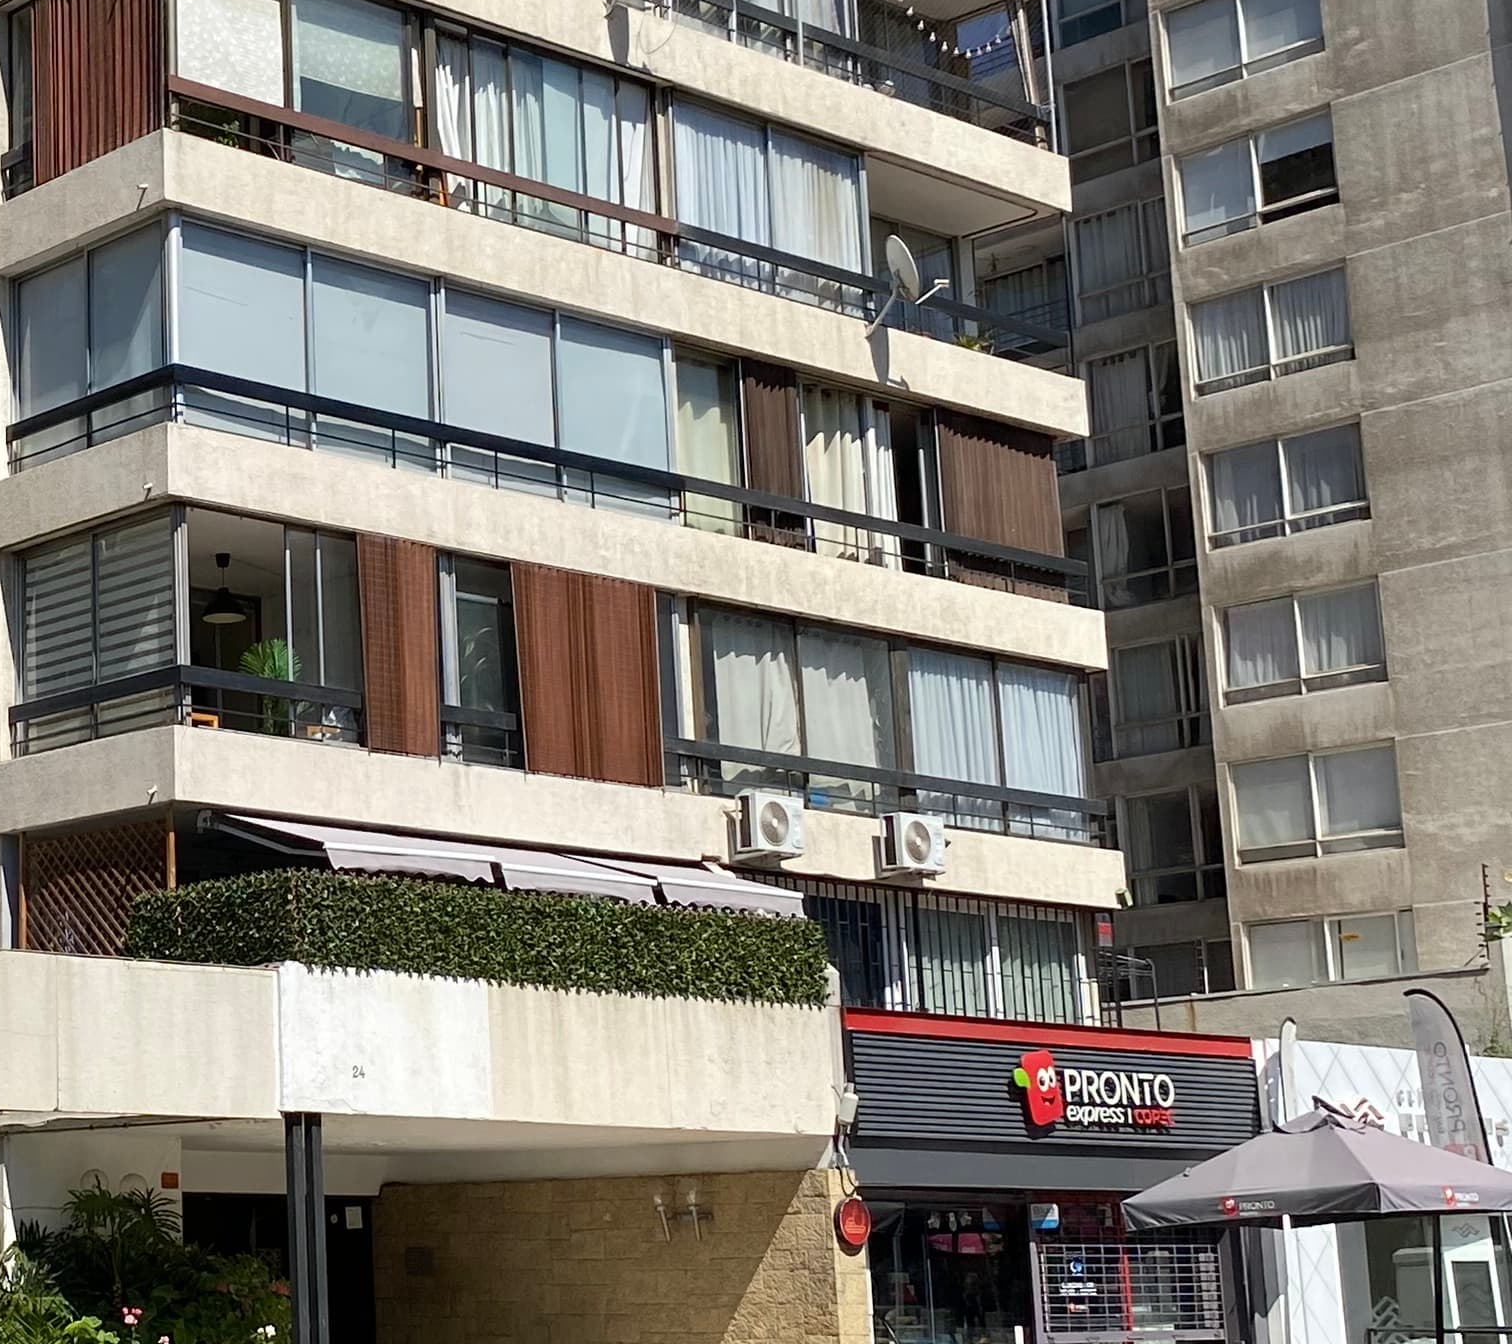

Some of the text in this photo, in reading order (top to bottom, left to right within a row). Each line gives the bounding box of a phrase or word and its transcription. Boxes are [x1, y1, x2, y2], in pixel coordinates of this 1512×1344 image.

[352, 1065, 366, 1079] 24
[1063, 1068, 1176, 1108] PRONTO
[1066, 1105, 1176, 1127] express COPEC
[1238, 1200, 1275, 1211] PRONTO
